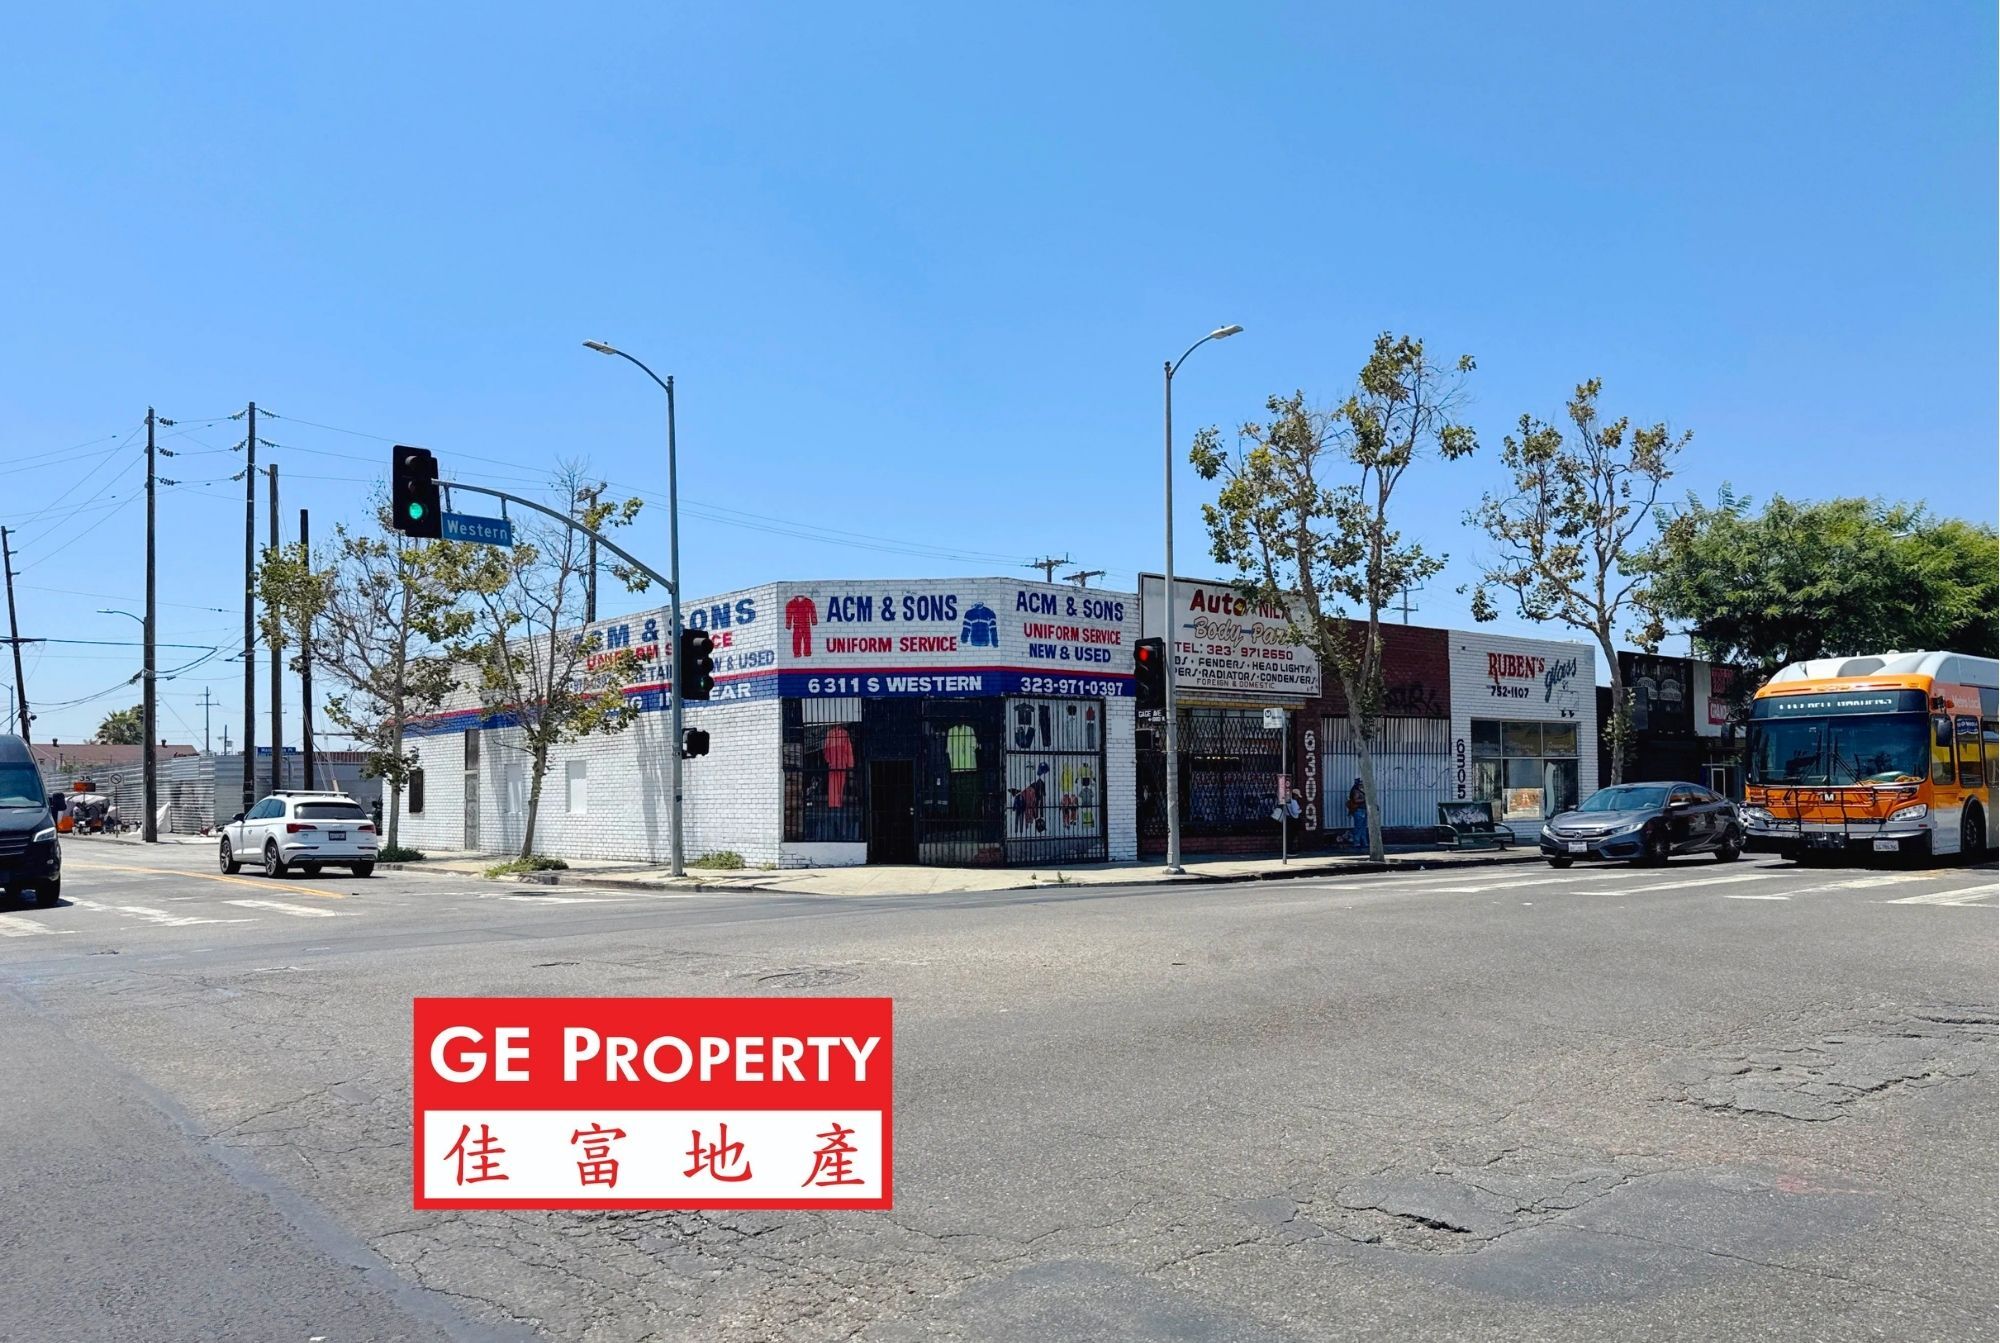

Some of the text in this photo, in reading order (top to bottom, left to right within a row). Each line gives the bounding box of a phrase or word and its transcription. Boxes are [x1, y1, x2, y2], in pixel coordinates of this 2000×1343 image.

[446, 519, 508, 540] Western
[826, 594, 958, 622] ACM & SONS
[1016, 591, 1124, 622] ACM & SONS
[1189, 588, 1247, 617] Auto
[642, 618, 658, 642] &
[1023, 623, 1121, 645] UNIFORM SERVICE
[1193, 616, 1244, 648] Body
[826, 636, 957, 653] UNIFORM SERVICE
[1029, 643, 1111, 663] NEW & USED
[1174, 641, 1203, 656] TEL:
[727, 655, 734, 671] &
[739, 649, 775, 669] USED
[1198, 657, 1246, 669] FENDERS
[1252, 662, 1278, 672] HEAD
[808, 676, 983, 693] 6311 S WESTERN
[1020, 677, 1124, 696] 323-971-0397
[1196, 678, 1229, 687] FOREIGN
[1239, 681, 1276, 690] DOMESTIC
[1201, 670, 1257, 682] RADIATORS
[1260, 673, 1317, 685] CONDENSERS
[1487, 652, 1577, 703] RUBEN'S glass
[1304, 729, 1318, 831] 6309
[1456, 738, 1466, 800] 6305
